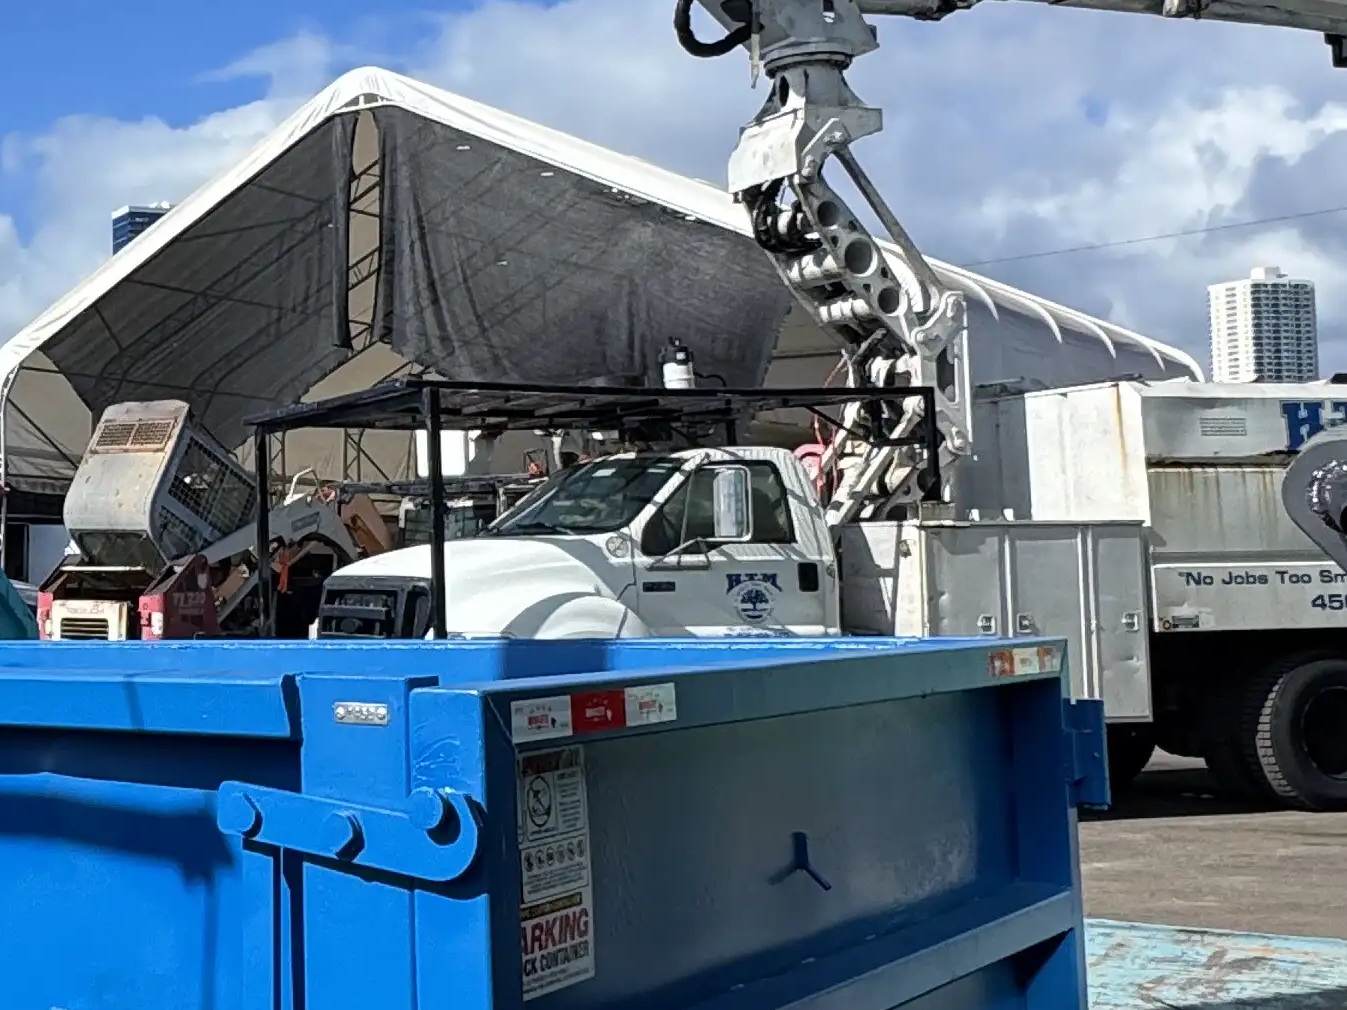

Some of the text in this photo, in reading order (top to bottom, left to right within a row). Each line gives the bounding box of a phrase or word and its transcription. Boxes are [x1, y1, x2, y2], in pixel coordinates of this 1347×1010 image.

[1221, 571, 1268, 585] Jobs
[1275, 569, 1312, 584] Too
[1311, 593, 1347, 610] 45
